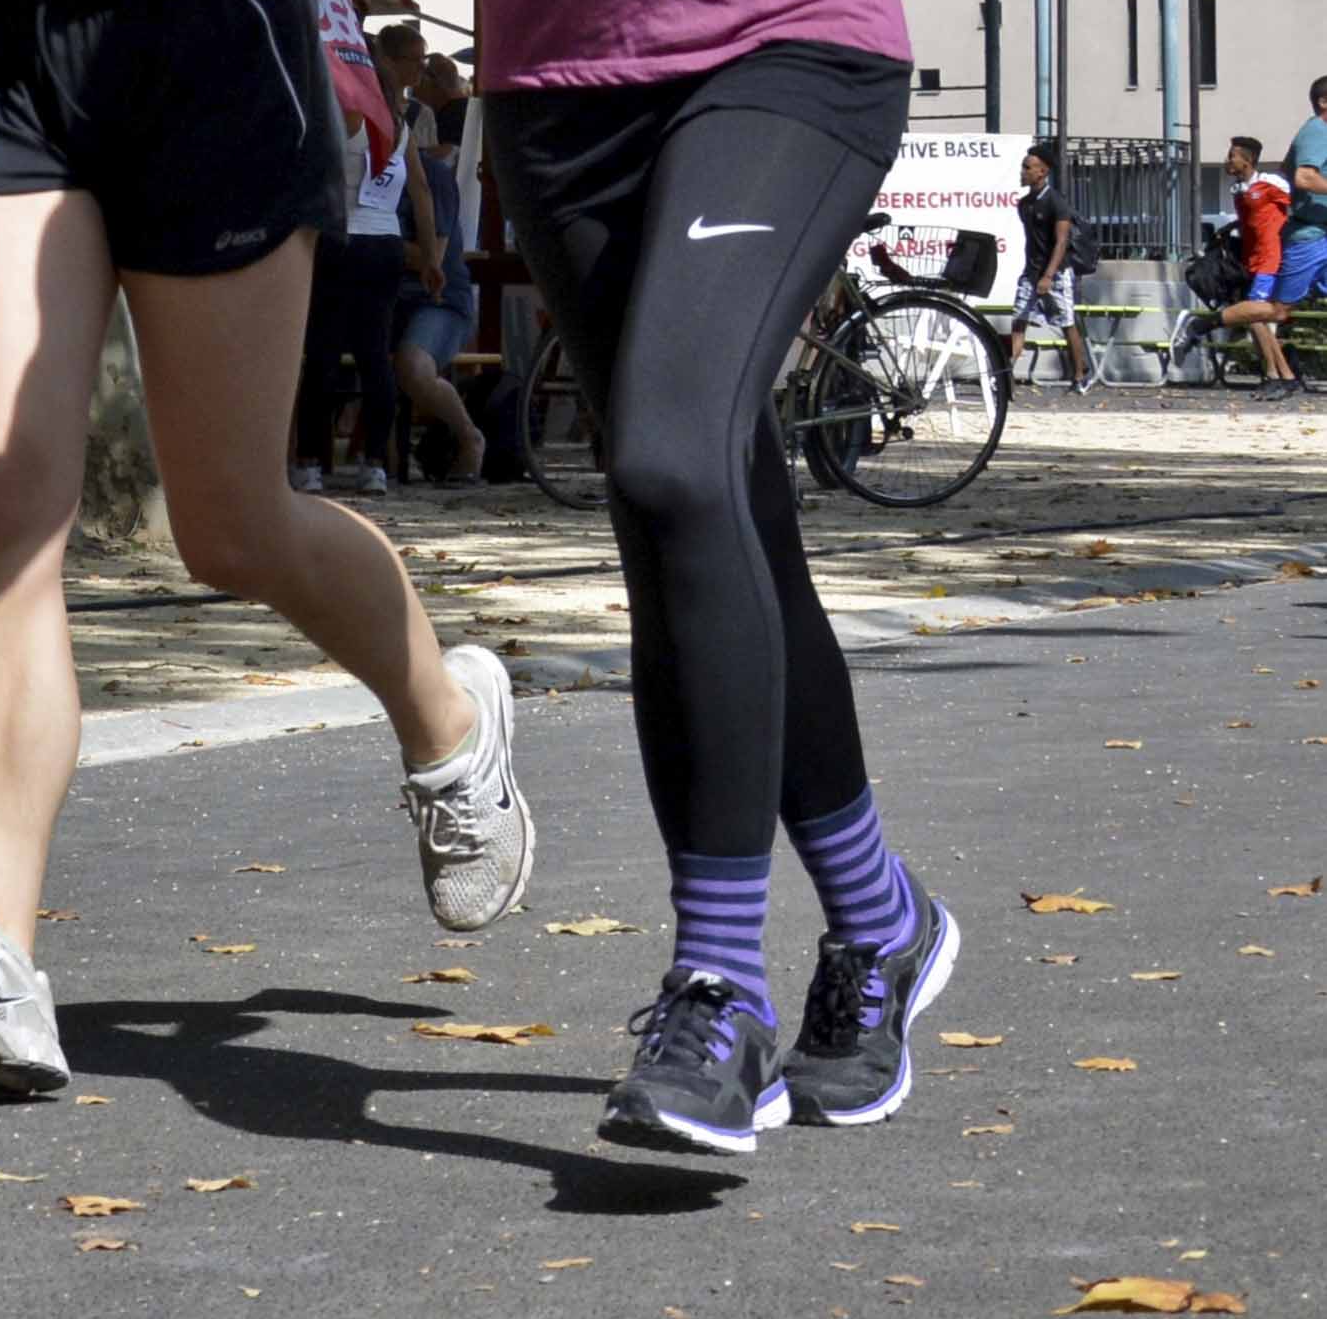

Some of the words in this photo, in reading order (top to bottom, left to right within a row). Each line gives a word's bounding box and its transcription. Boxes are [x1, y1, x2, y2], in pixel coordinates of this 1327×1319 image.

[899, 141, 939, 159] TIVE
[944, 140, 1001, 159] BASEL
[877, 191, 1020, 209] BERECHTIGUNG
